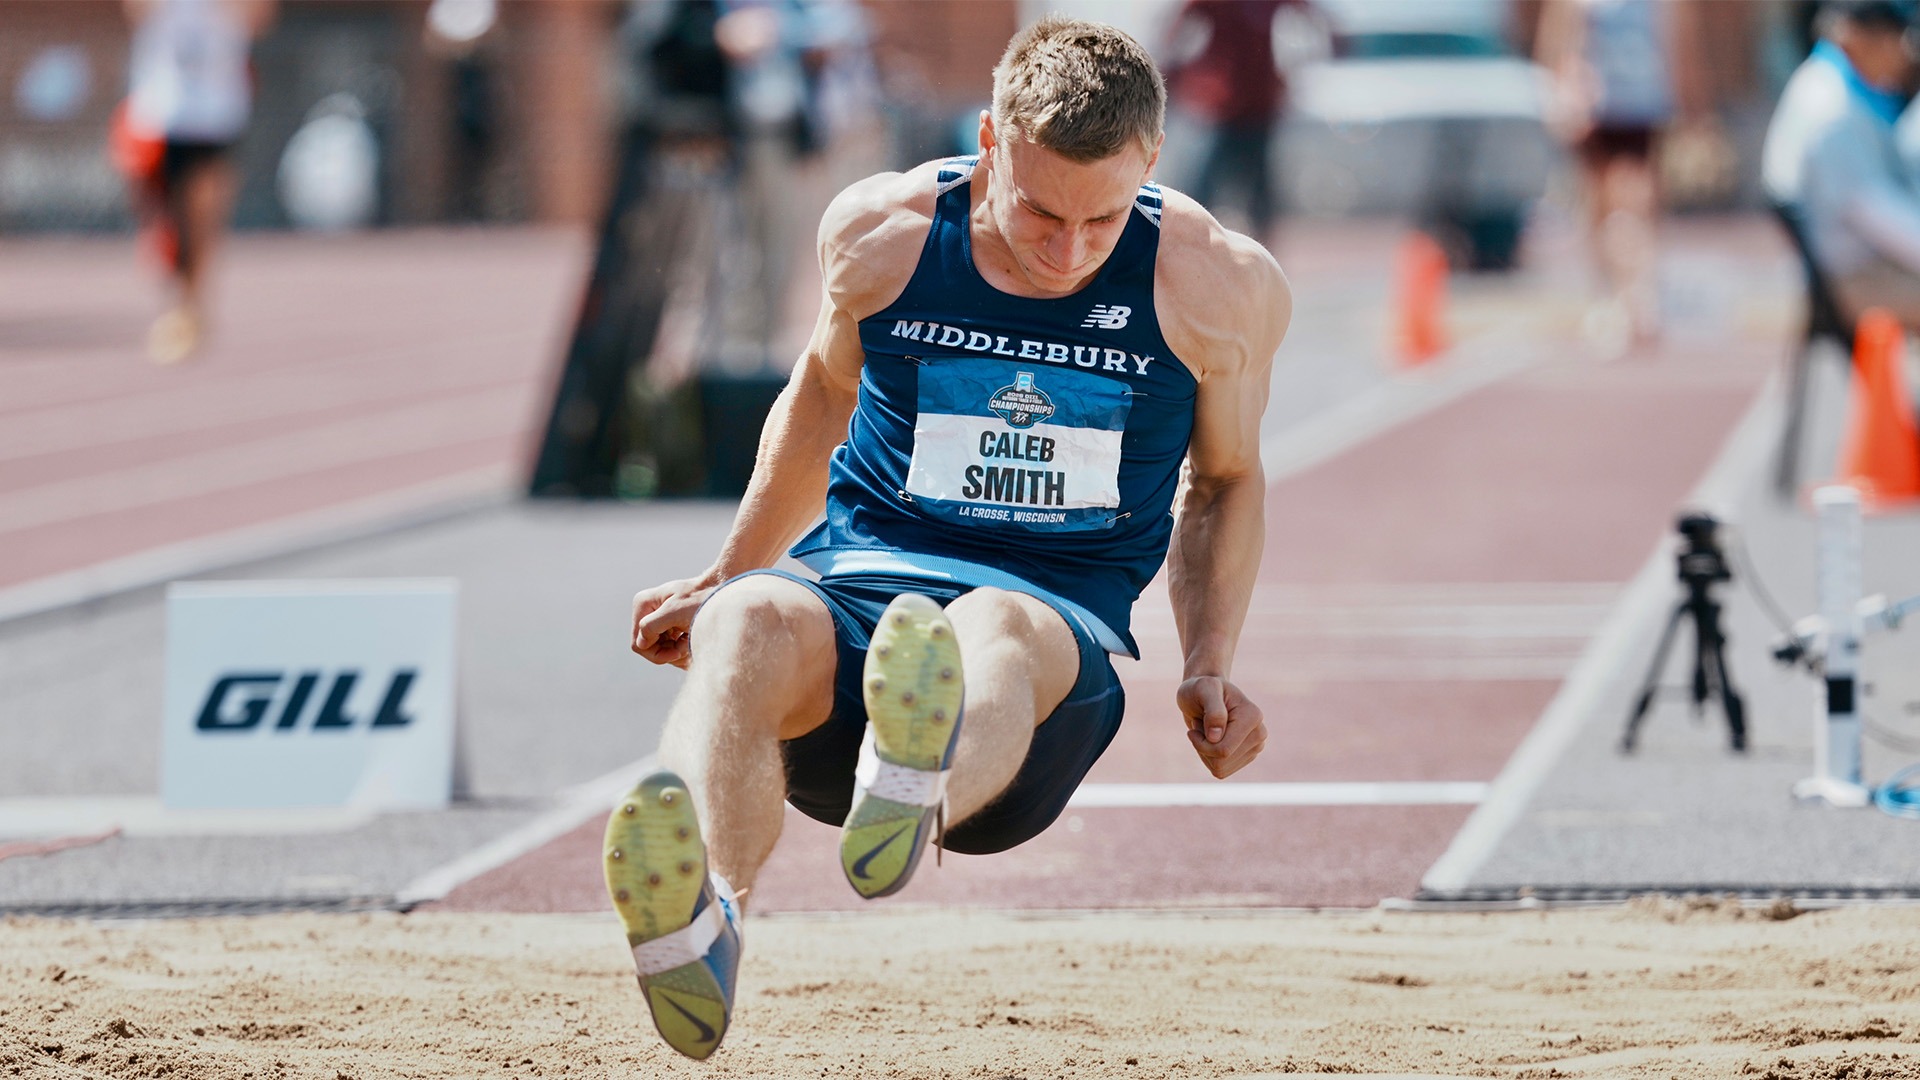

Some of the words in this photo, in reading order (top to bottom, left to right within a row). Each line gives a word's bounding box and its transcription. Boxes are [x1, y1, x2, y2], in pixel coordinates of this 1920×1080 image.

[1081, 304, 1132, 329] NB
[890, 320, 1154, 375] MIDDLEBURY
[990, 400, 1053, 415] CHAMPIONSHIPS
[979, 430, 1056, 462] CALEB
[962, 465, 1065, 506] SMITH
[959, 506, 970, 516] LA
[971, 509, 1010, 522] CROSSE,
[1013, 511, 1066, 523] WISCONSIN
[195, 669, 418, 731] GILL
